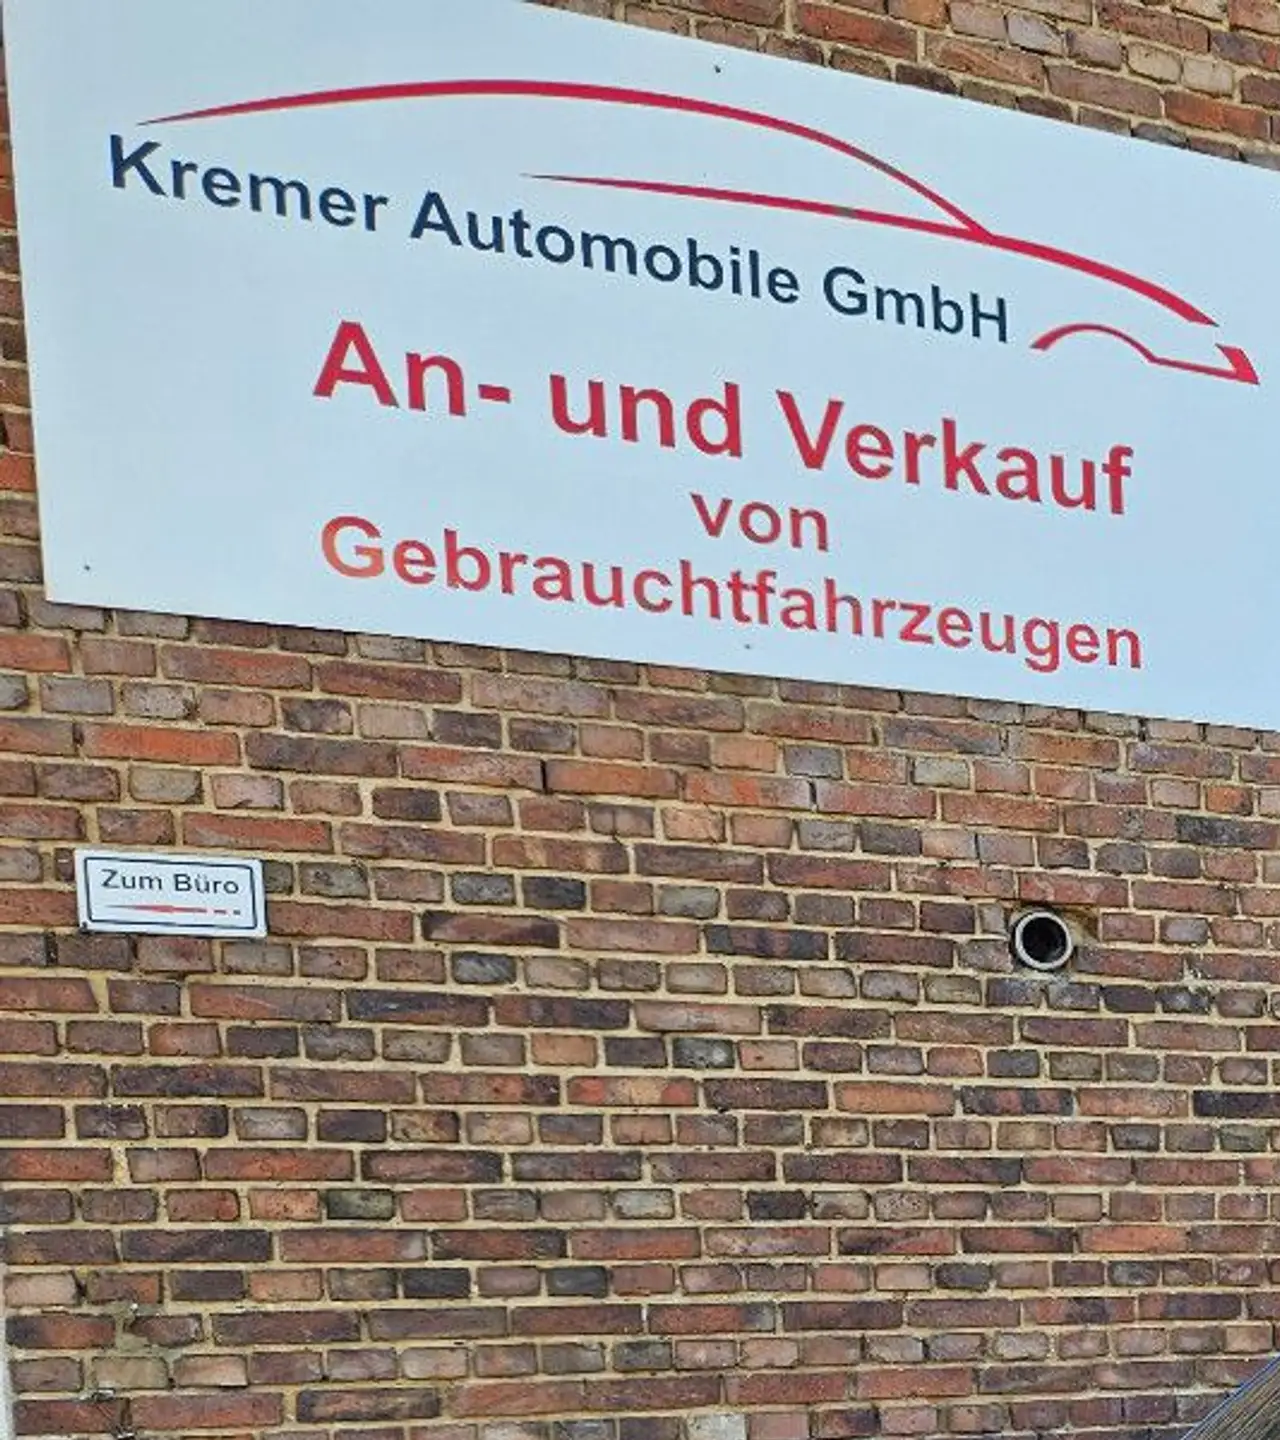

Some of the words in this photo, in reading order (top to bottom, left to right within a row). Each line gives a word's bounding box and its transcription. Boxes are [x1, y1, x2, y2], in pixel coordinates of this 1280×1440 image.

[109, 134, 389, 232] Kremer
[410, 190, 801, 304] Automobile
[823, 266, 1008, 344] GmbH
[314, 320, 512, 416] An-
[550, 374, 742, 458] und
[778, 391, 1132, 515] Verkauf
[322, 515, 1143, 674] Gebrauchtfahrzeugen
[692, 494, 830, 551] von
[101, 868, 163, 891] Zum
[173, 872, 240, 895] Büro
